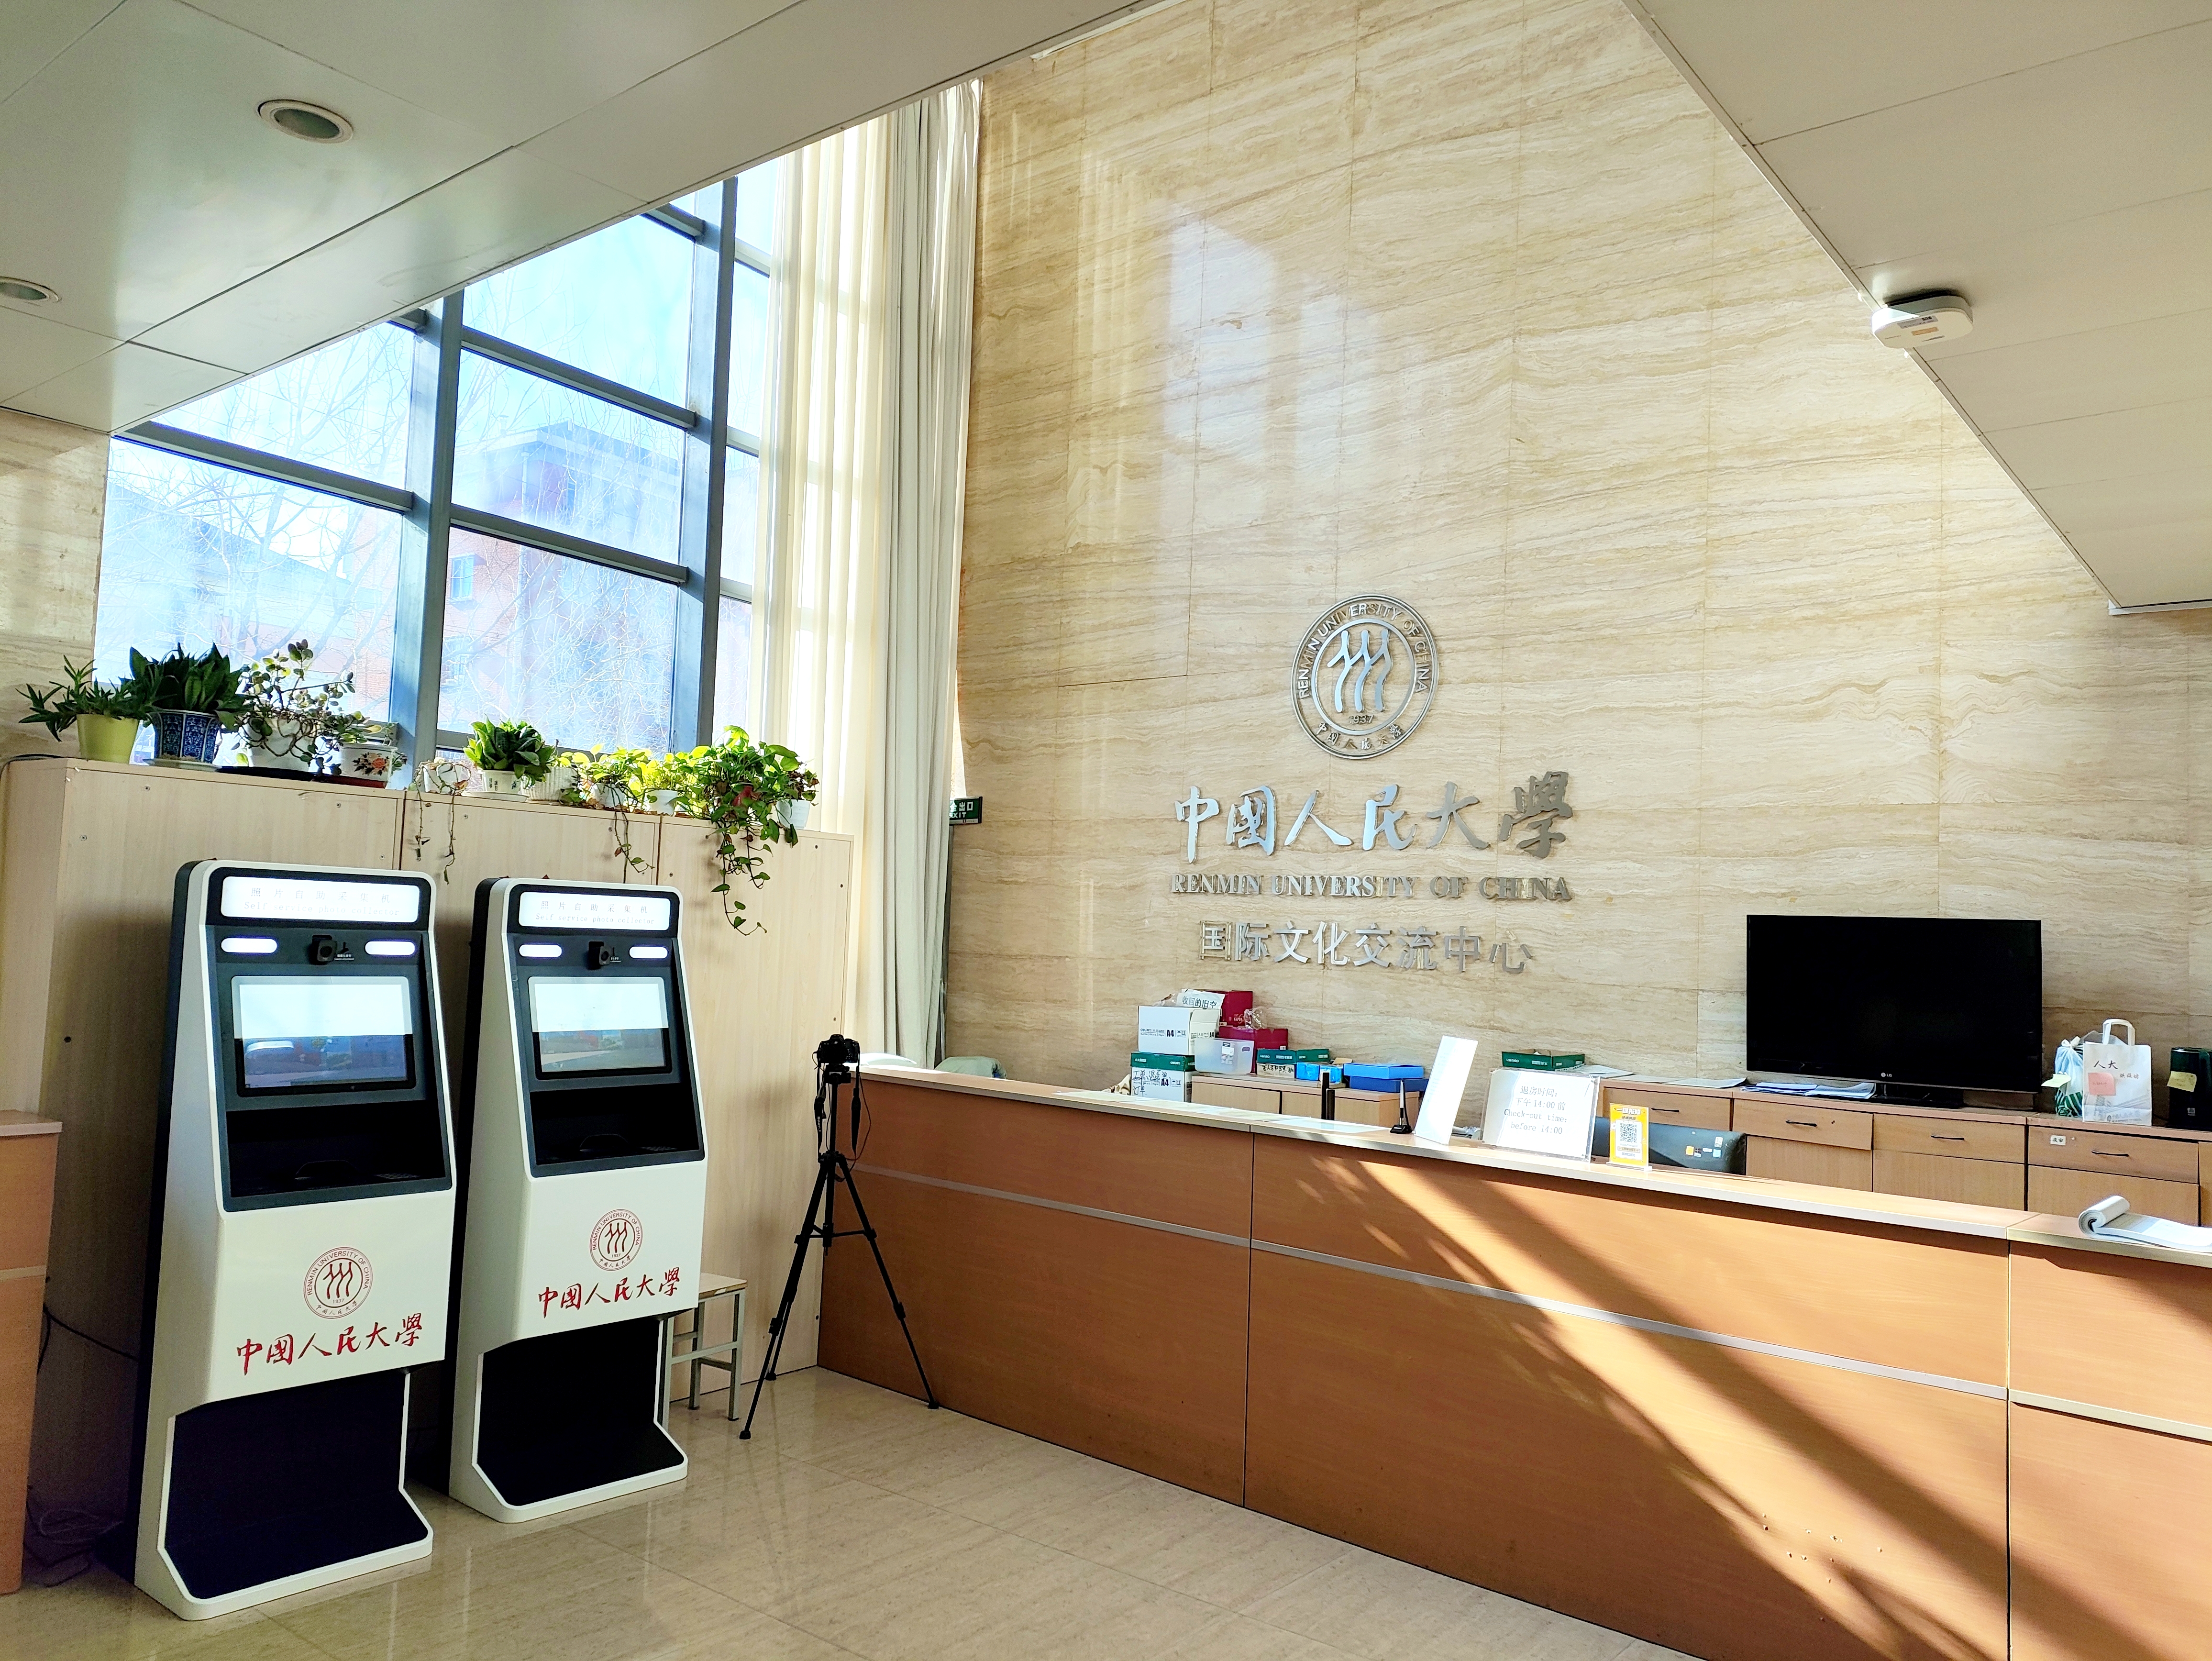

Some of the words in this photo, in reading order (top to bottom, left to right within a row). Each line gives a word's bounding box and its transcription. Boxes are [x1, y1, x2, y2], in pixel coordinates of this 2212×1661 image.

[1298, 638, 1320, 699] RENMIN
[1317, 603, 1402, 637] UNIVERSITY
[1403, 620, 1420, 637] OF
[1415, 641, 1430, 693] CHINA
[1349, 714, 1374, 724] 1937
[251, 887, 390, 903] 照片自助采集机
[1172, 874, 1261, 895] RENMIN
[1271, 875, 1420, 898] UNIVERSITY
[1430, 876, 1468, 898] OF
[1479, 876, 1573, 901] CHINA
[244, 901, 268, 910] Self
[274, 904, 312, 912] service
[319, 905, 345, 914] photo
[351, 907, 399, 916] collector
[541, 901, 648, 914] 照片自助采集机
[1200, 920, 1533, 974] 国际文化交流中心
[2093, 1060, 2118, 1070] 人大
[1520, 1086, 1557, 1097] 退房时间：
[1515, 1097, 1531, 1107] 下午
[1534, 1100, 1555, 1108] 14:00
[1558, 1102, 1566, 1110] 前
[1504, 1108, 1542, 1119] Check-out
[1548, 1114, 1567, 1123] time:
[1511, 1122, 1536, 1131] before
[1541, 1125, 1563, 1134] 14:00
[592, 1226, 601, 1251] RENMIN
[600, 1212, 632, 1226] UNIVERSITY
[307, 1267, 319, 1296] RENMIN
[317, 1251, 358, 1267] UNIVERSITY
[358, 1258, 366, 1266] OF
